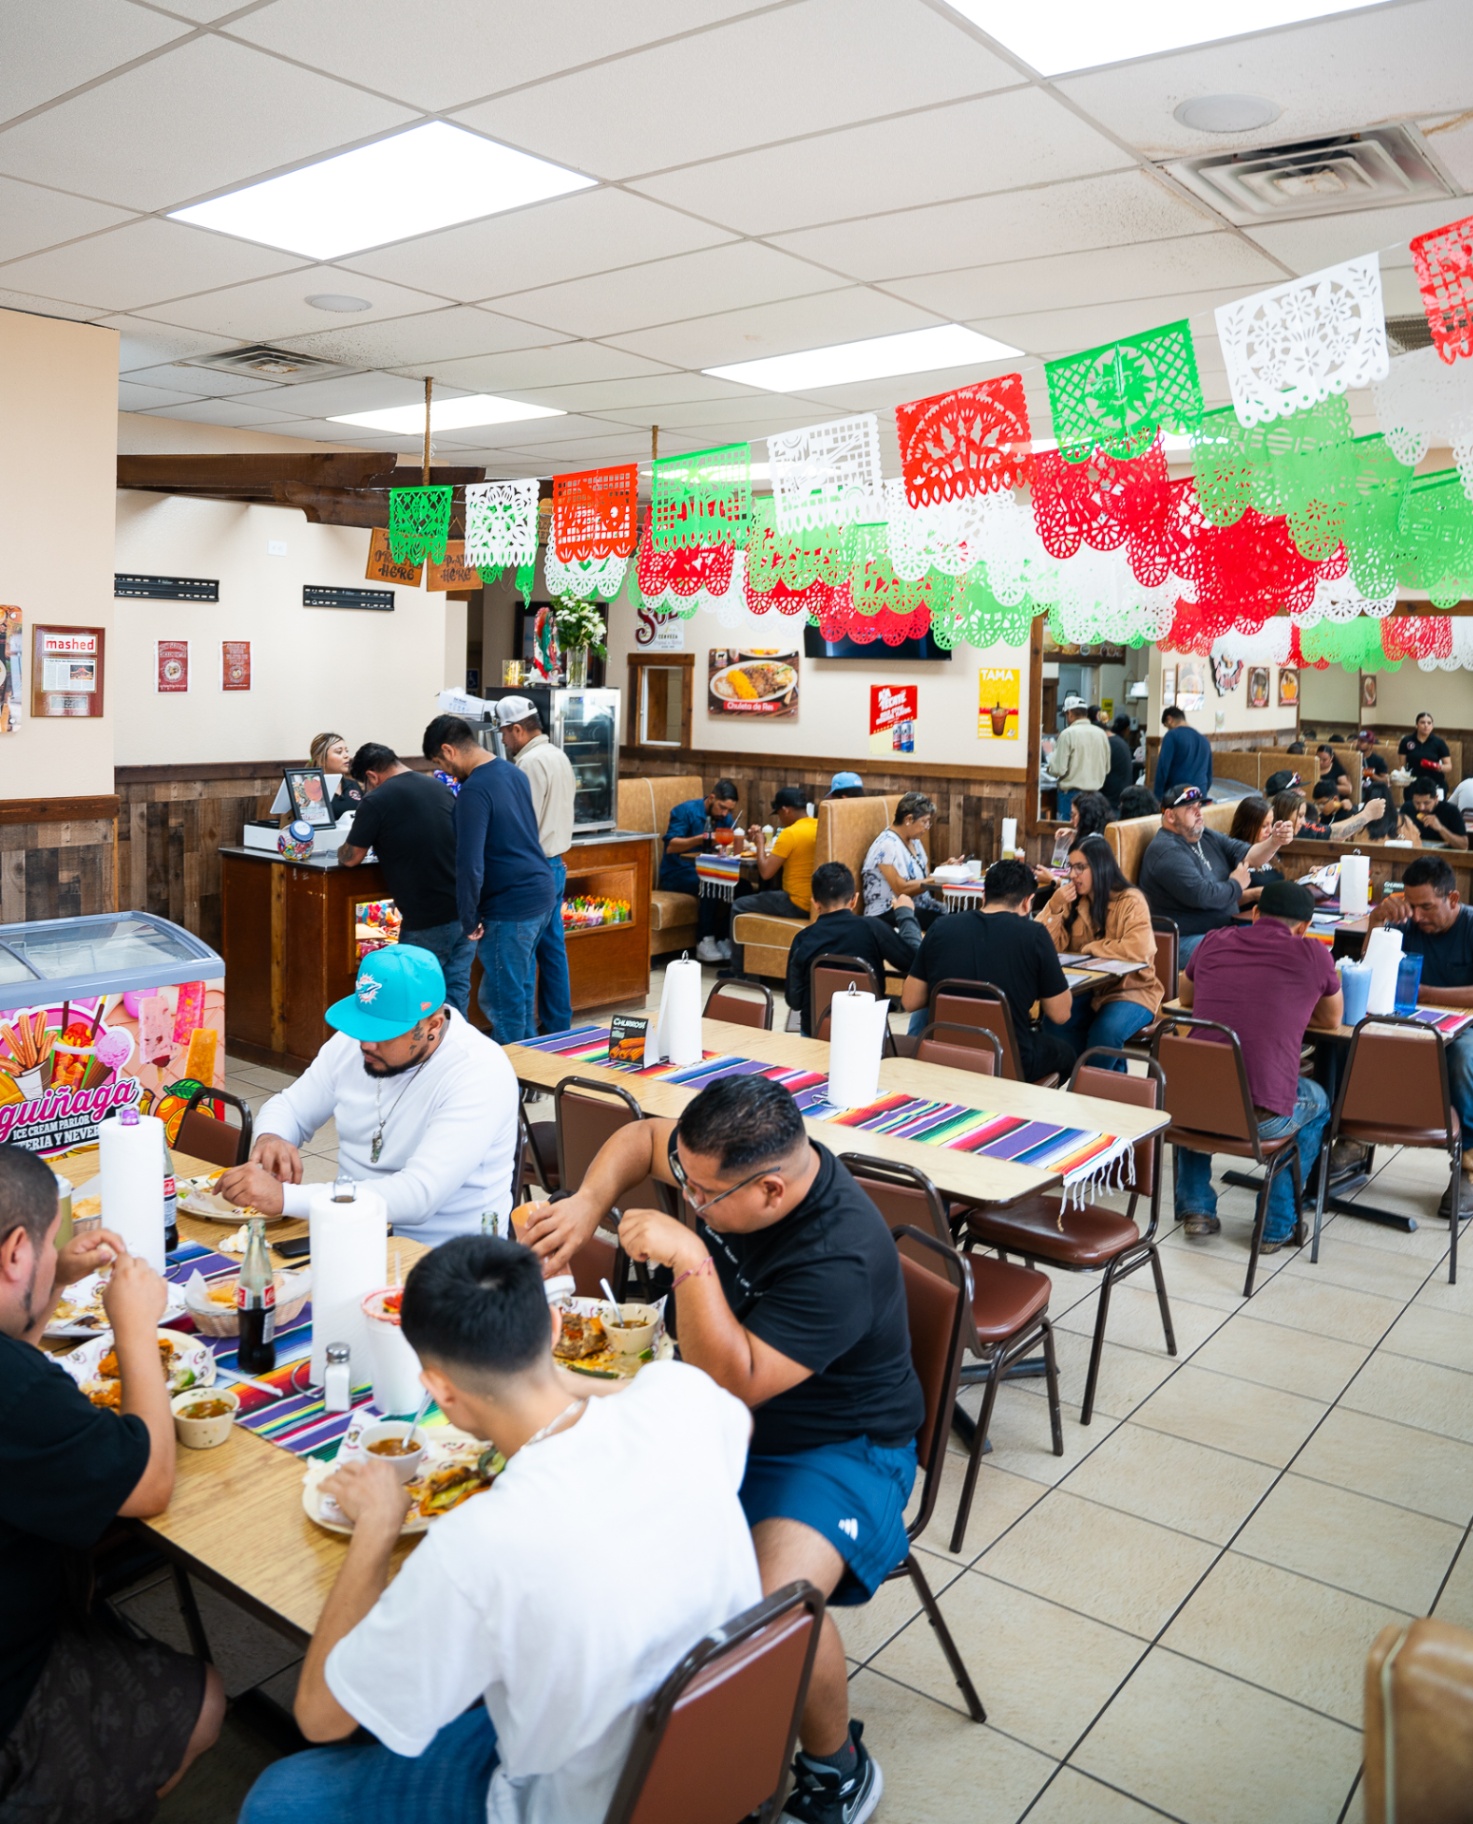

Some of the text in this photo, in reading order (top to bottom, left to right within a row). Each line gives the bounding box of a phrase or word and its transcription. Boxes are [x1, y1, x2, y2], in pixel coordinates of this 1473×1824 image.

[378, 564, 414, 580] HERE
[441, 567, 471, 582] HERE
[46, 639, 94, 649] mashed
[981, 669, 1014, 680] TAMA
[727, 702, 751, 710] Chuleta
[0, 1081, 136, 1143] guiñaga
[13, 1115, 90, 1140] ICE CREAM PARLOR
[53, 1131, 63, 1147] Y
[63, 1125, 99, 1142] NEVER
